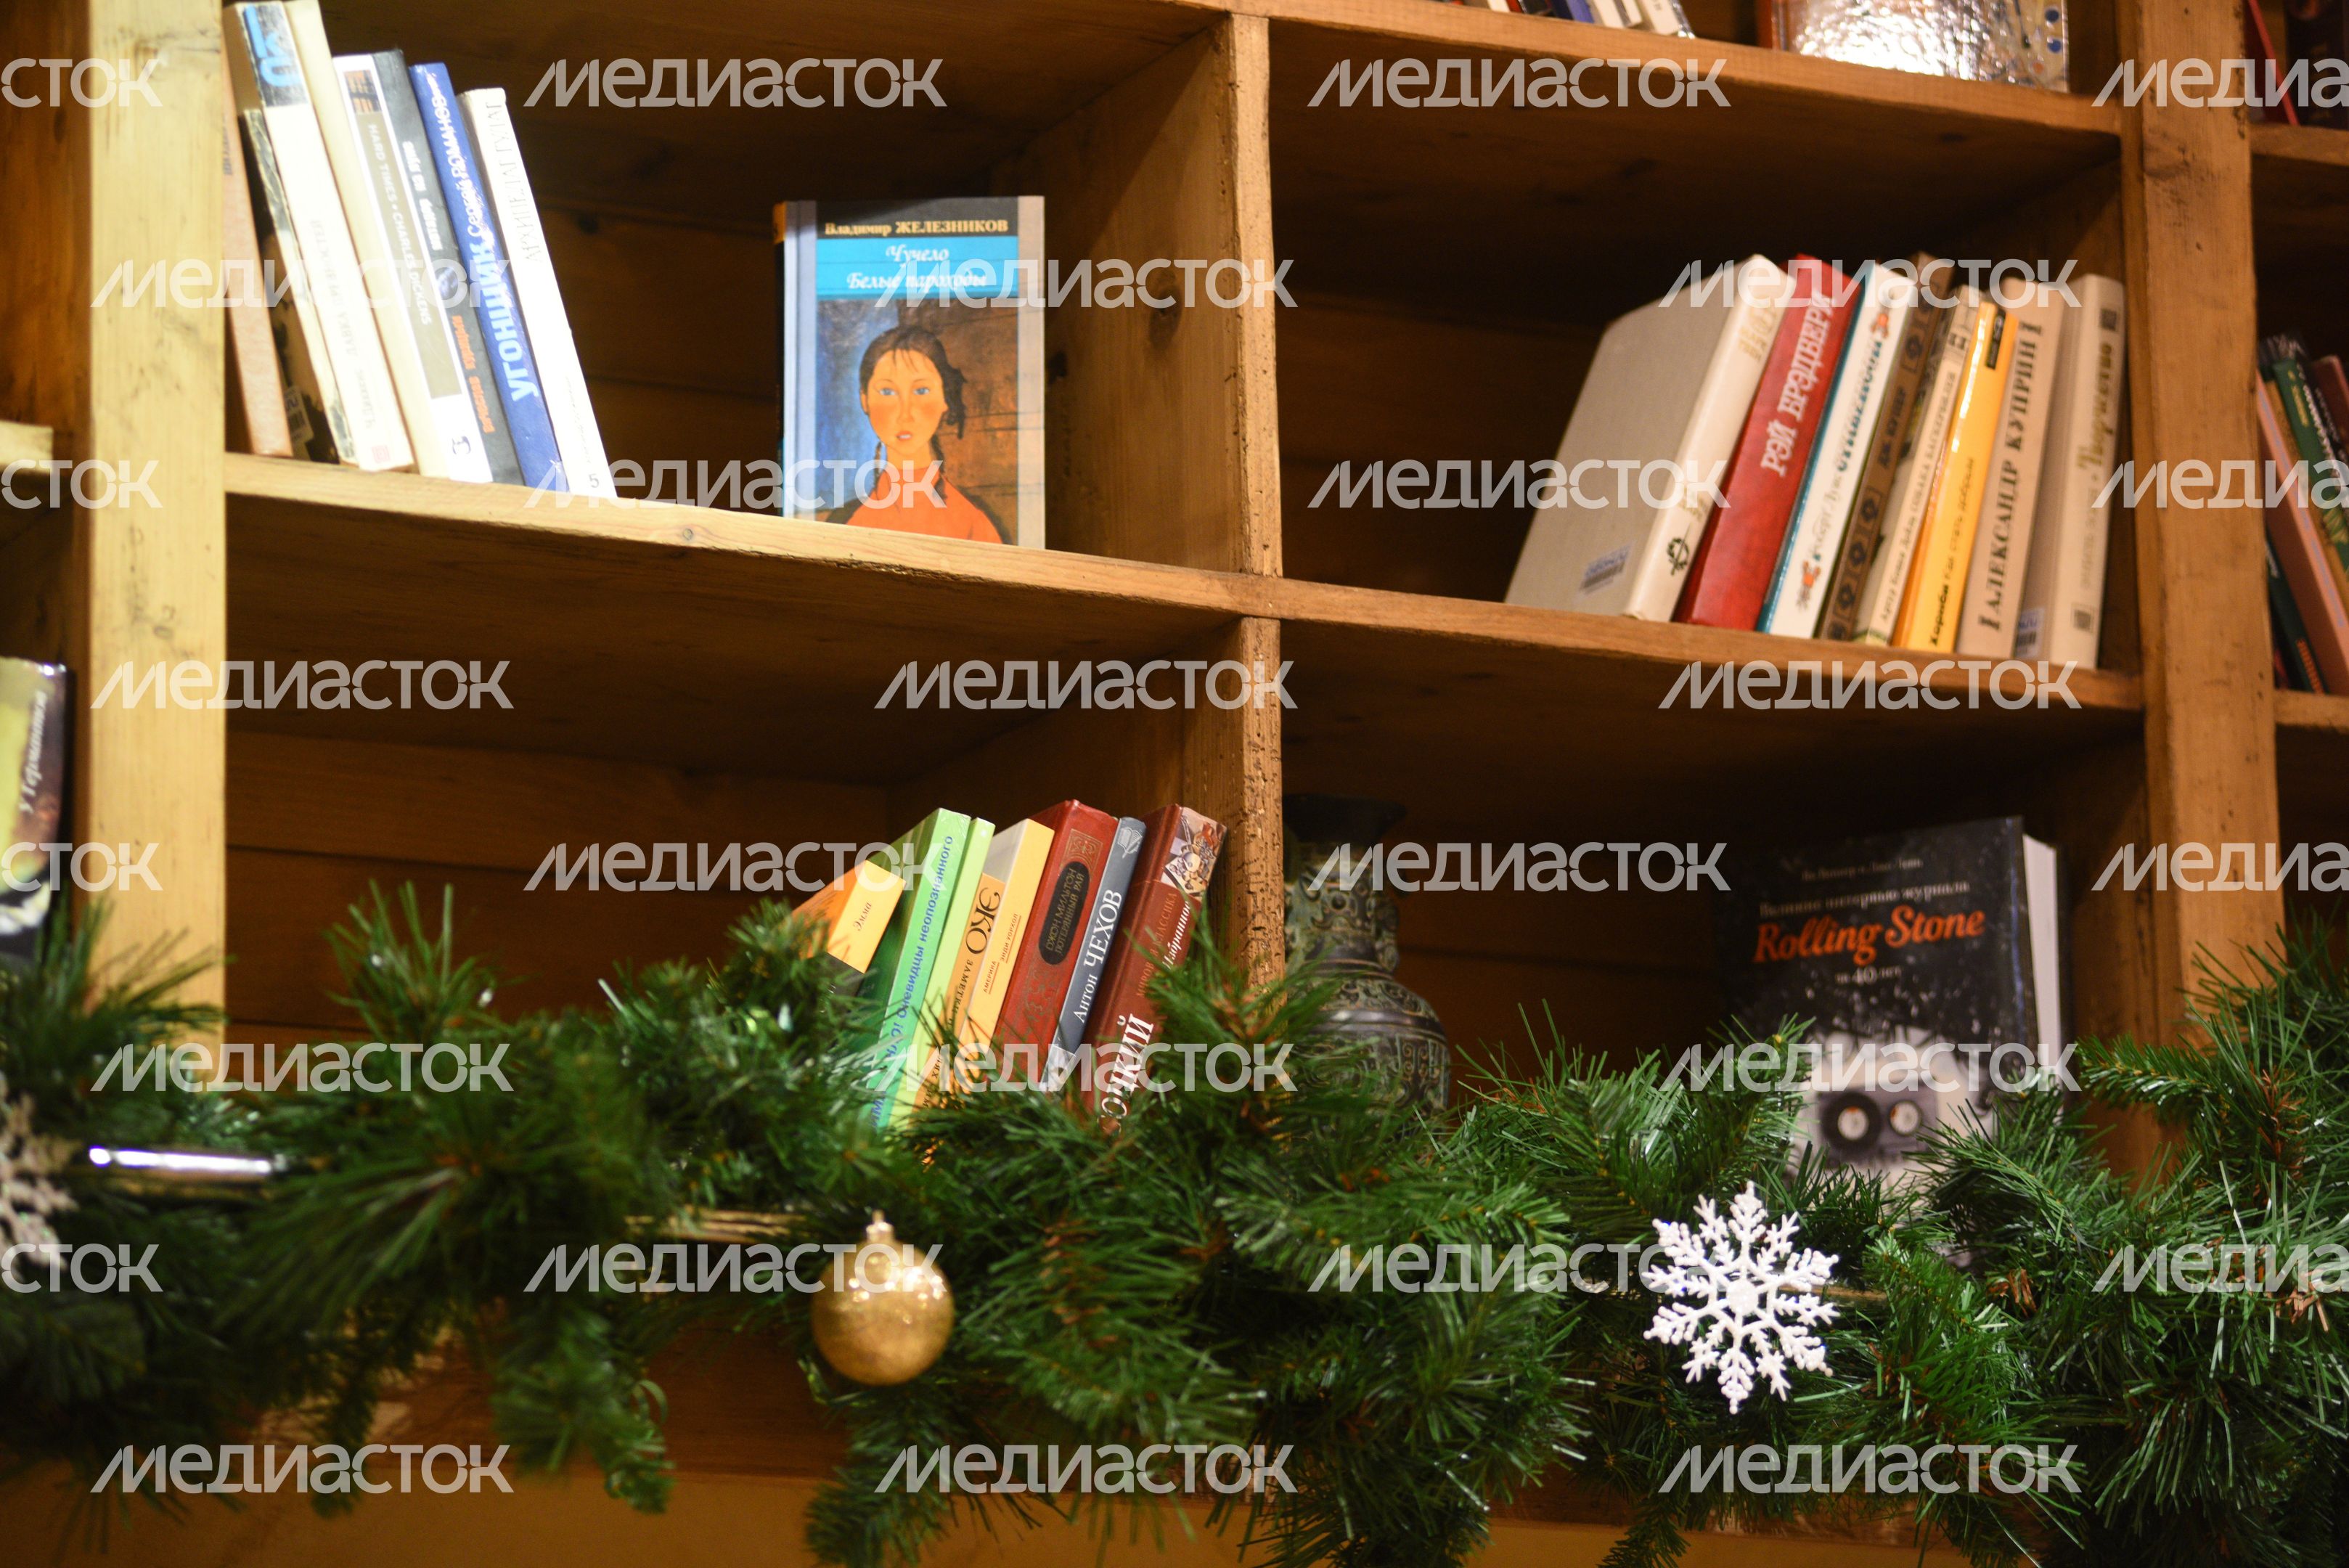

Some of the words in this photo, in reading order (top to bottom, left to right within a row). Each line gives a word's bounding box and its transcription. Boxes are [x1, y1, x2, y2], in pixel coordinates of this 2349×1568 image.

[485, 101, 512, 152] ГУЛАГ
[367, 123, 386, 161] HARD
[379, 163, 398, 203] TIMES
[392, 212, 417, 271] CHARLES
[409, 270, 433, 327] DICKENS
[824, 222, 893, 237] Владимир
[894, 219, 1009, 234] ЖЕЛЕЗНИКОВ
[846, 271, 900, 289] Белые
[885, 244, 950, 267] Чучело
[1760, 417, 1798, 478] РЭЙ
[588, 473, 600, 489] 5
[1985, 459, 2019, 616] АЛЕКСАНДР
[2006, 341, 2038, 452] КУПРИН
[852, 901, 873, 932] Эмма
[896, 944, 925, 1020] Очевидцы
[918, 835, 954, 944] неопознанного
[965, 886, 1002, 955] ЭКО
[1005, 912, 1019, 942] УОРХОЛ
[1046, 918, 1062, 952] ДЖОН
[1055, 868, 1077, 920] МИЛЬТОН
[1054, 893, 1079, 956] ПОТЕРЯННЫЙ
[1072, 871, 1085, 891] РАЙ
[1082, 888, 1123, 968] ЧЕХОВ
[1162, 900, 1190, 970] Избранное
[1752, 914, 1884, 967] Rolling
[1884, 905, 1987, 948] Stone
[1000, 942, 1012, 963] ЭНДИ
[1135, 947, 1160, 999] МИРОВЯ
[1852, 965, 1878, 985] 40
[951, 960, 974, 1018] ЗАМЕТКИ
